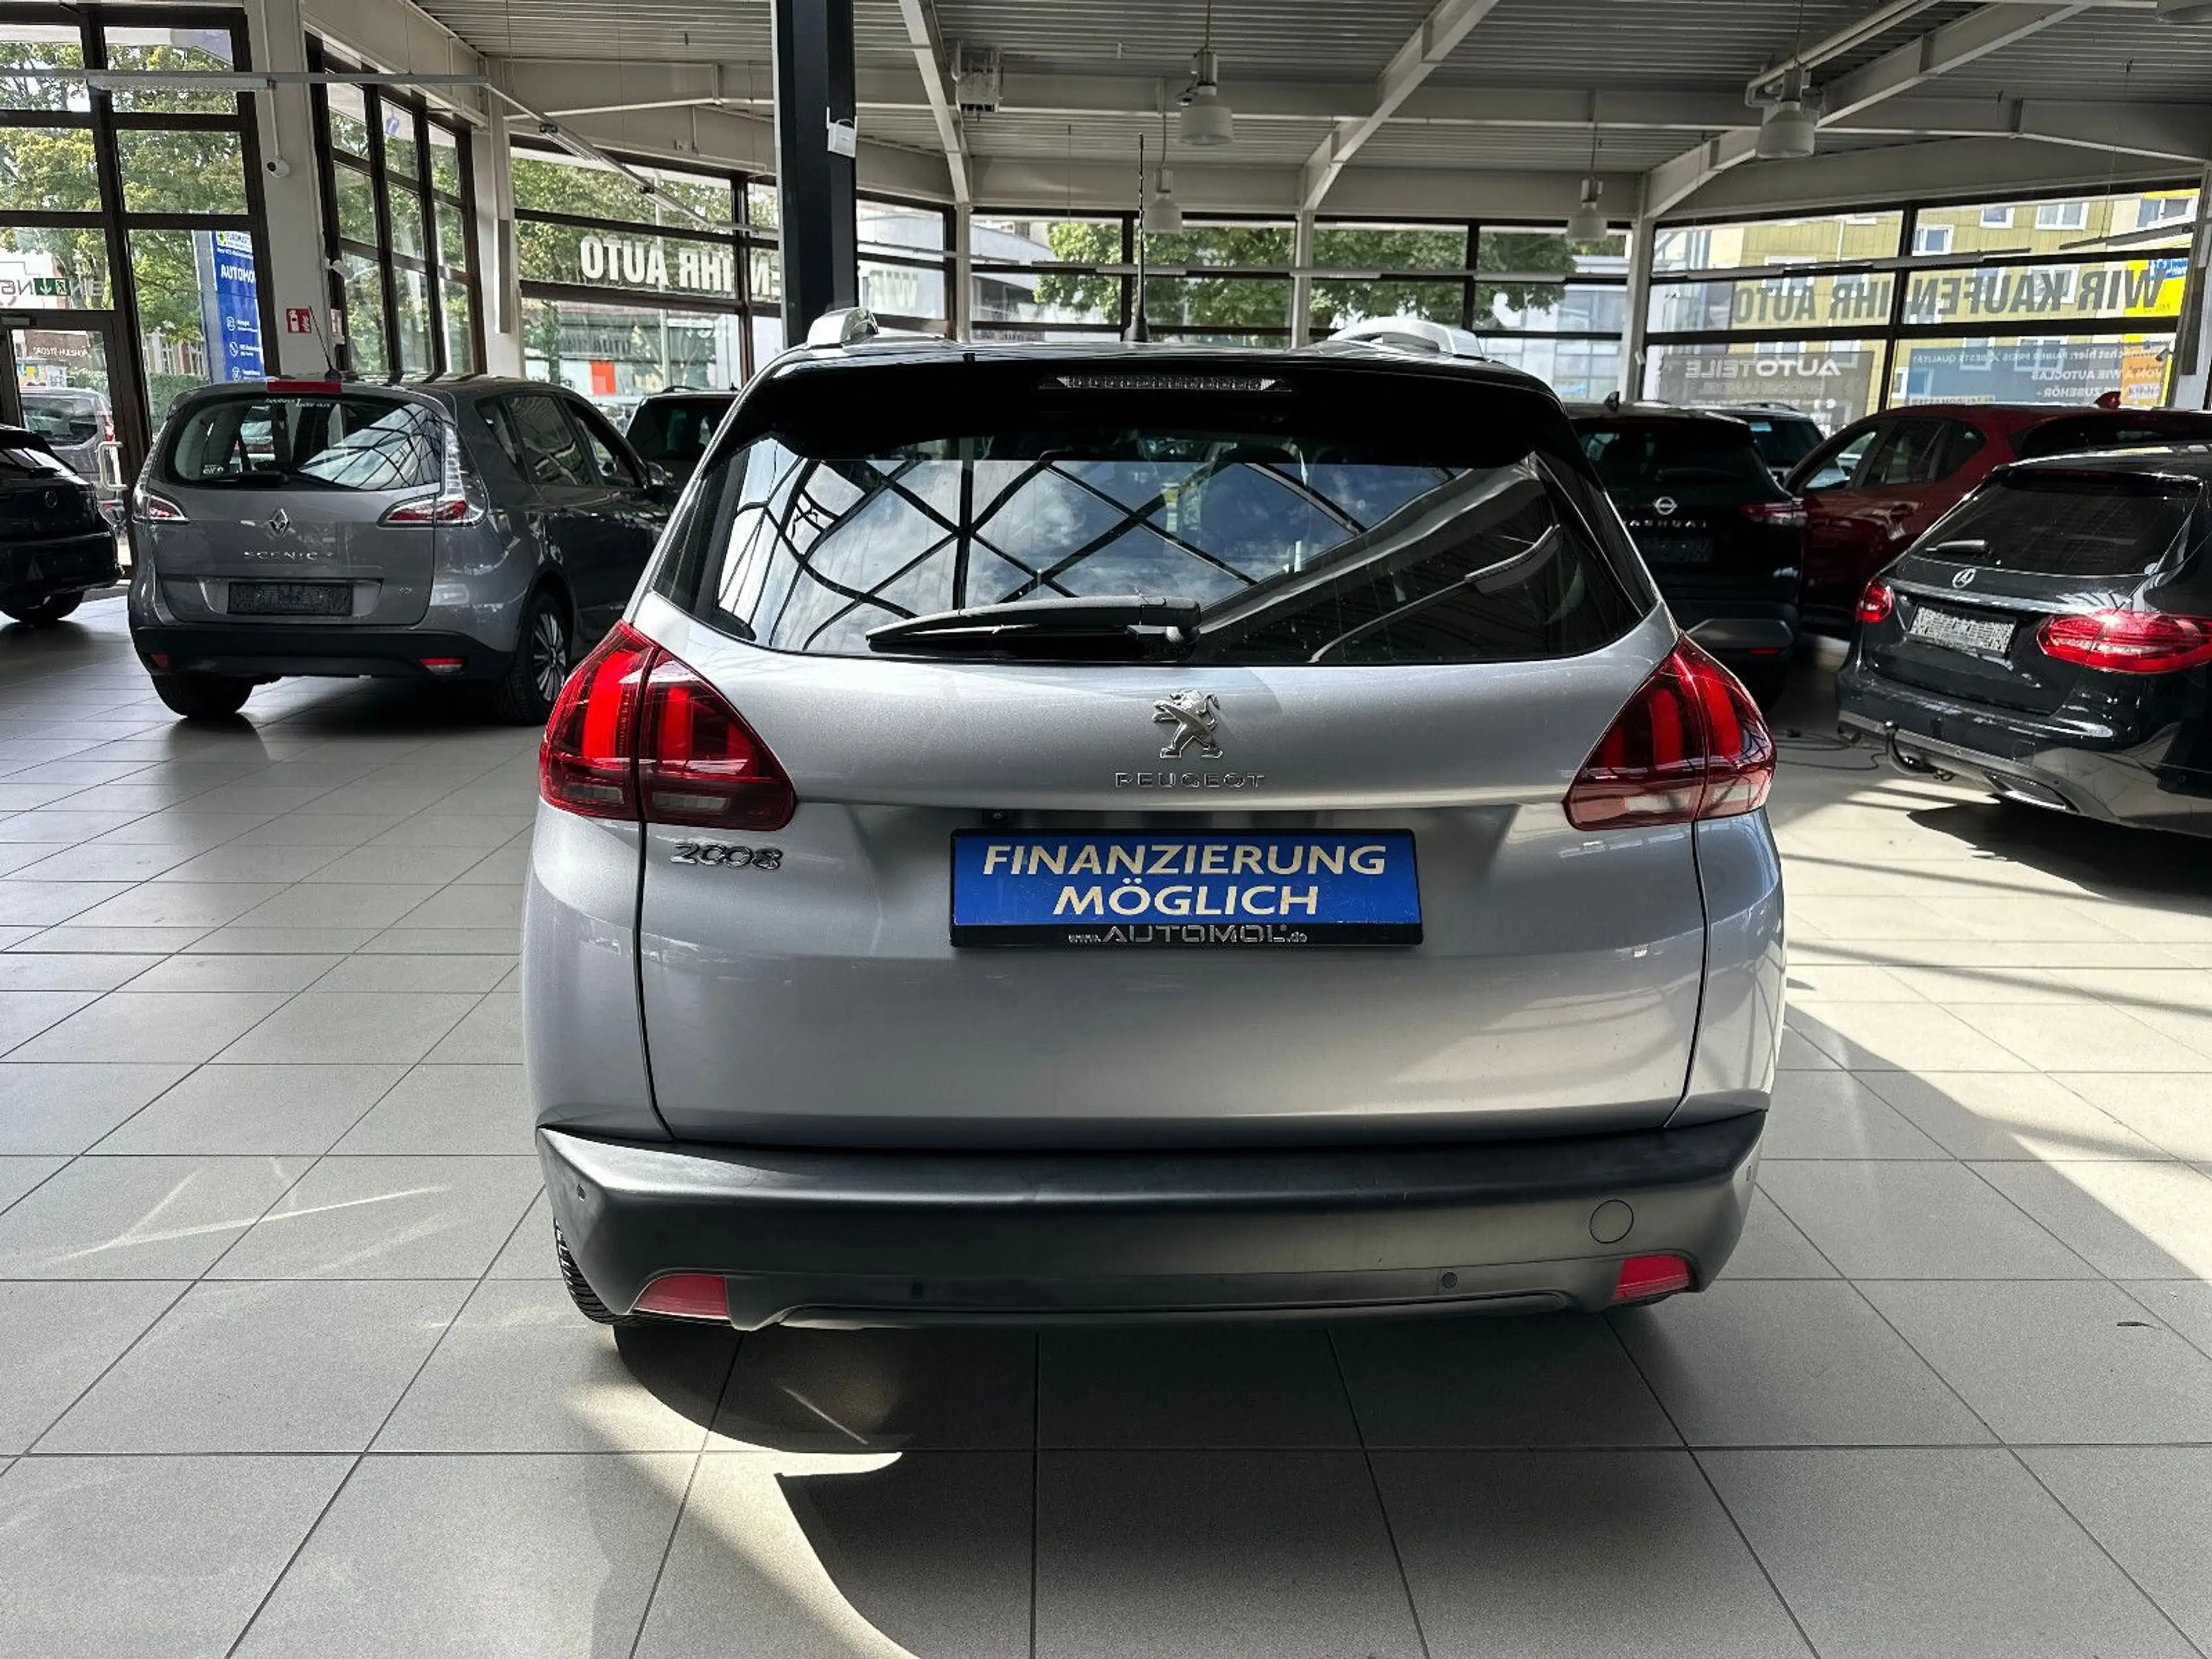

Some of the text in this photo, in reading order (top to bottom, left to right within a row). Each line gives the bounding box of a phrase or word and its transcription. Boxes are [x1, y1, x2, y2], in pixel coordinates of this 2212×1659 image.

[221, 264, 256, 283] AUTOMO
[1623, 520, 1707, 528] ASHQAI
[1115, 772, 1264, 787] PEUGEOT
[670, 843, 783, 870] 2008
[983, 844, 1386, 875] FINANZIERUNG
[1052, 877, 1319, 915] MÖGLICH
